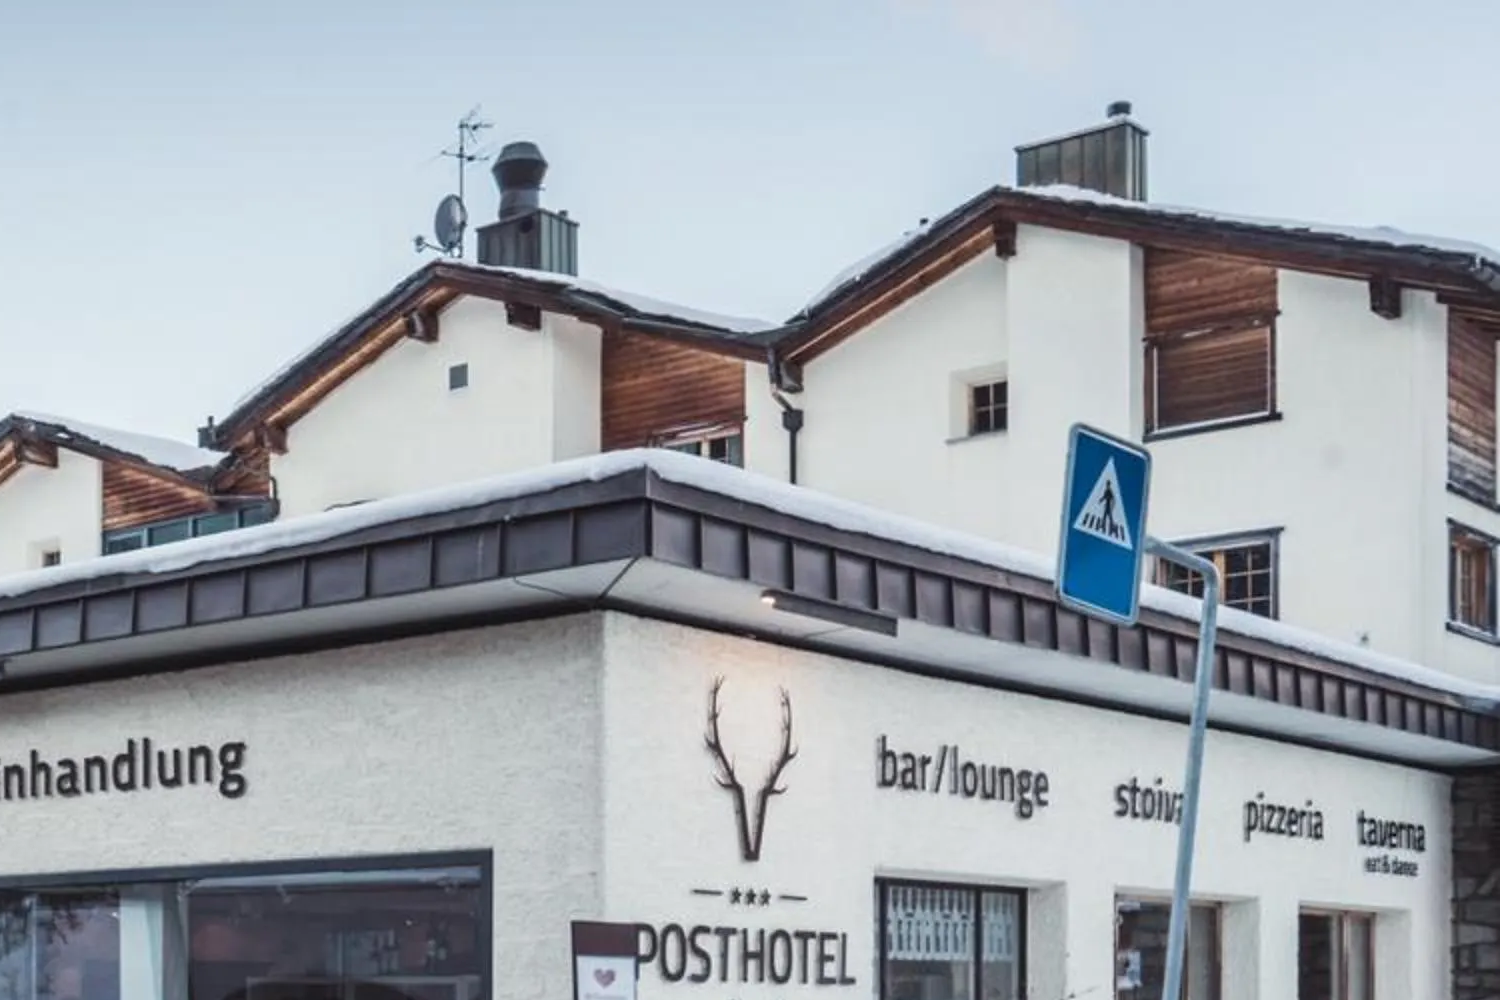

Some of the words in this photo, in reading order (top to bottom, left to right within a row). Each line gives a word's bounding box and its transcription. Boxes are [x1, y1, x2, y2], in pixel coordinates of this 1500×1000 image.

[876, 735, 1049, 819] bar/lounge
[1243, 792, 1324, 842] pizzeria
[1357, 809, 1425, 852] taverna
[636, 922, 856, 985] POSTHOTEL
